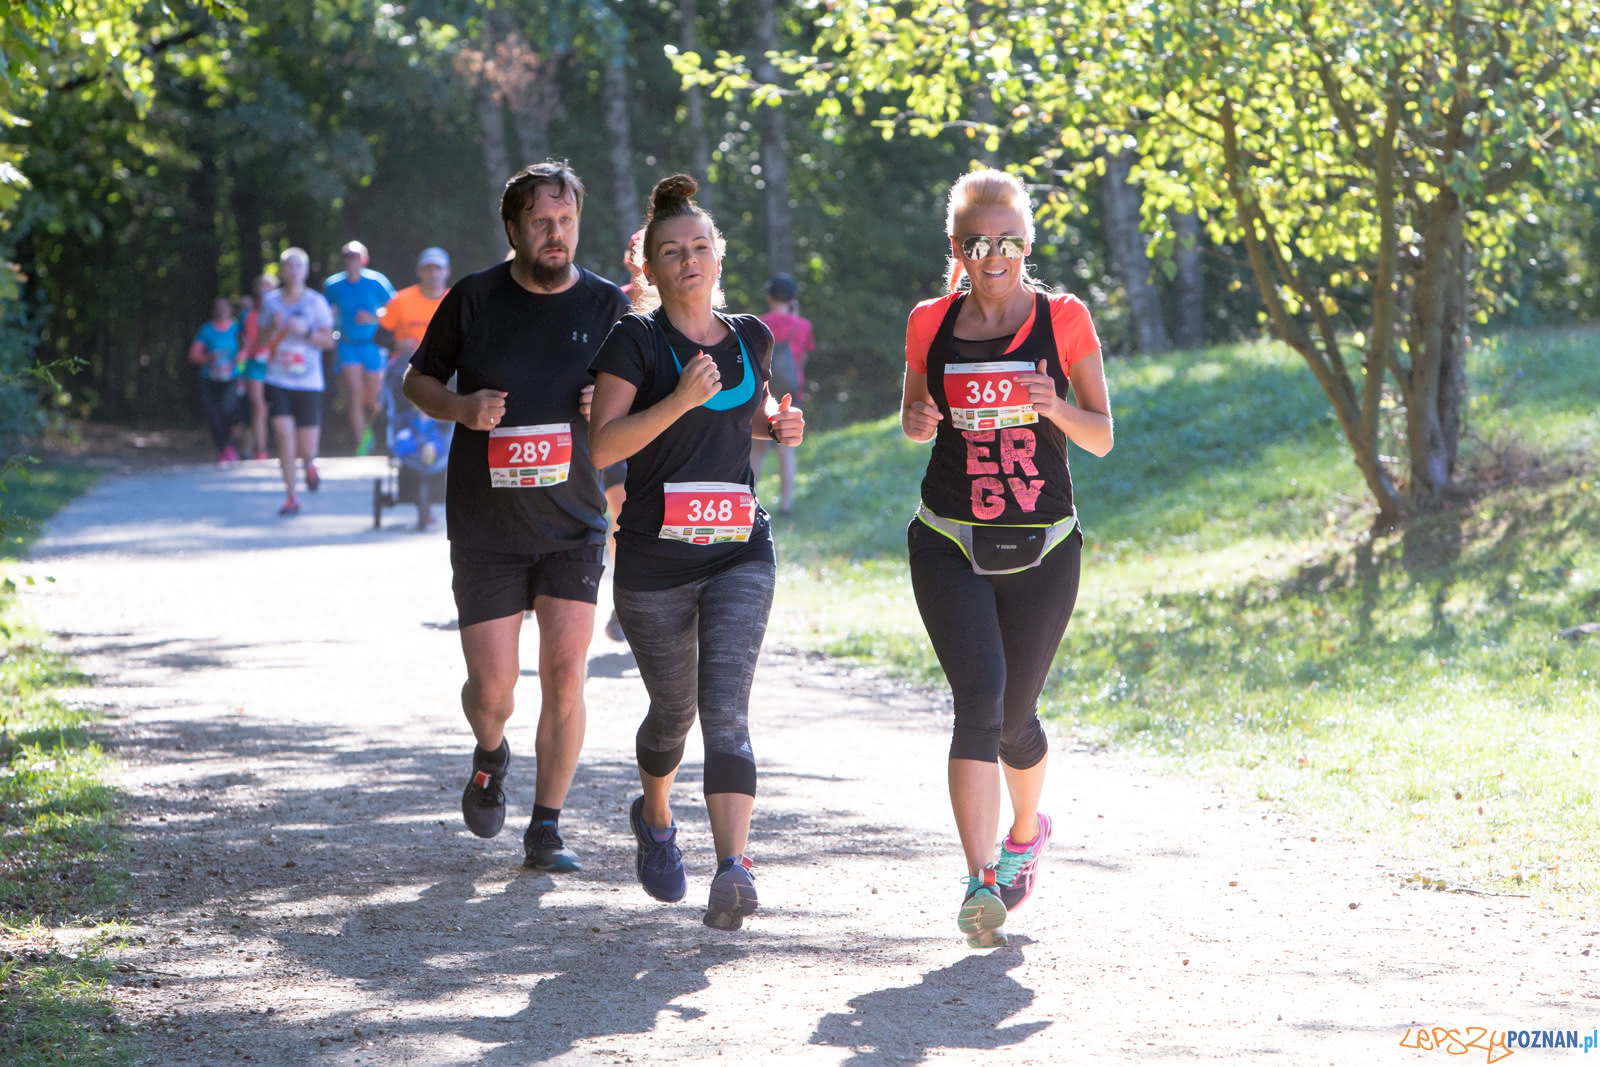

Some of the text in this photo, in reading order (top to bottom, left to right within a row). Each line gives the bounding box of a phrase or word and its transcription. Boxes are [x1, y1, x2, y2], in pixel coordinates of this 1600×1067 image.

[966, 379, 1012, 404] 369
[508, 440, 551, 464] 289
[961, 427, 1039, 477] ER
[687, 499, 732, 522] 368
